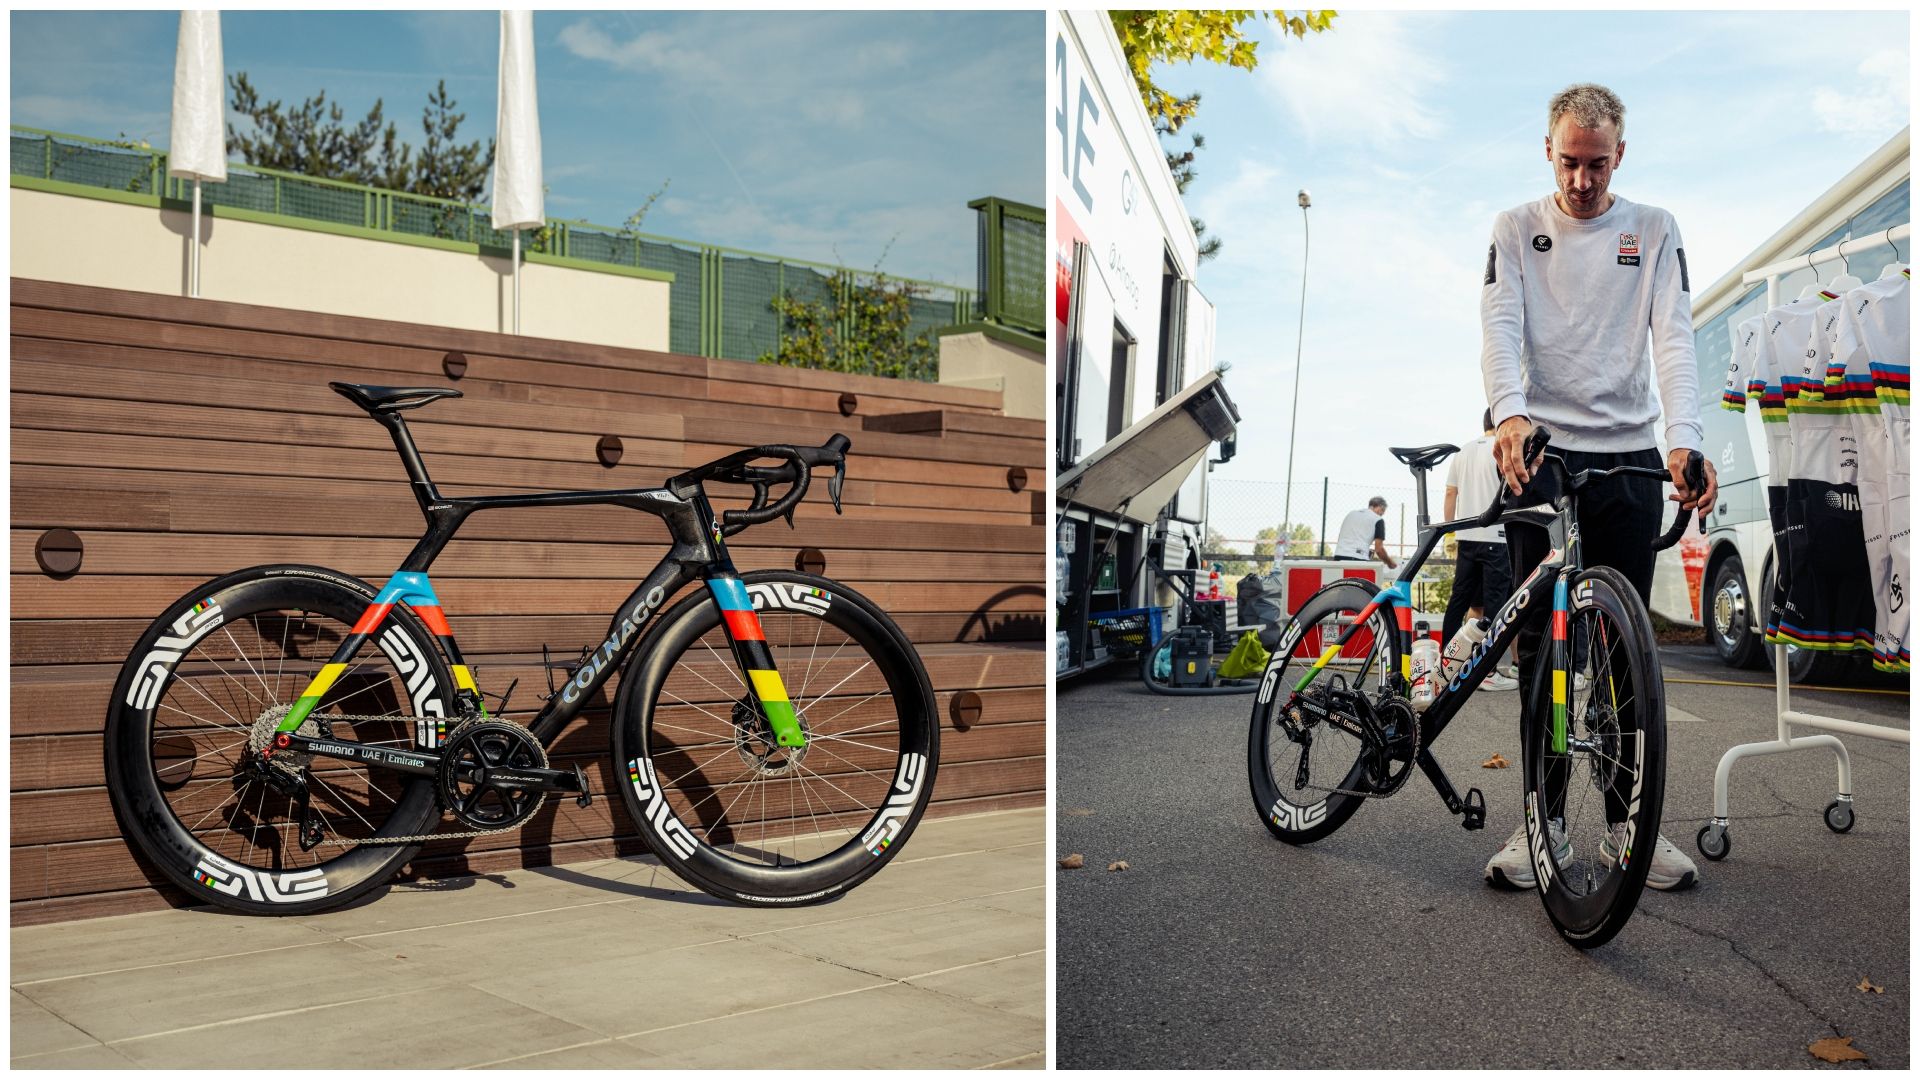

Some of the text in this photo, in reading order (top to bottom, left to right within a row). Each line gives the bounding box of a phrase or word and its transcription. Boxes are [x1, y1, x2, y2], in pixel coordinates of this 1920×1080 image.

[562, 585, 665, 704] COLNAGO
[1449, 588, 1531, 692] COLNAGO
[1302, 701, 1328, 717] SHIMANO
[1329, 712, 1341, 723] UAE
[308, 742, 355, 756] SHIMANO
[361, 749, 425, 768] UAE Emirates
[490, 774, 543, 783] DURA-ACE
